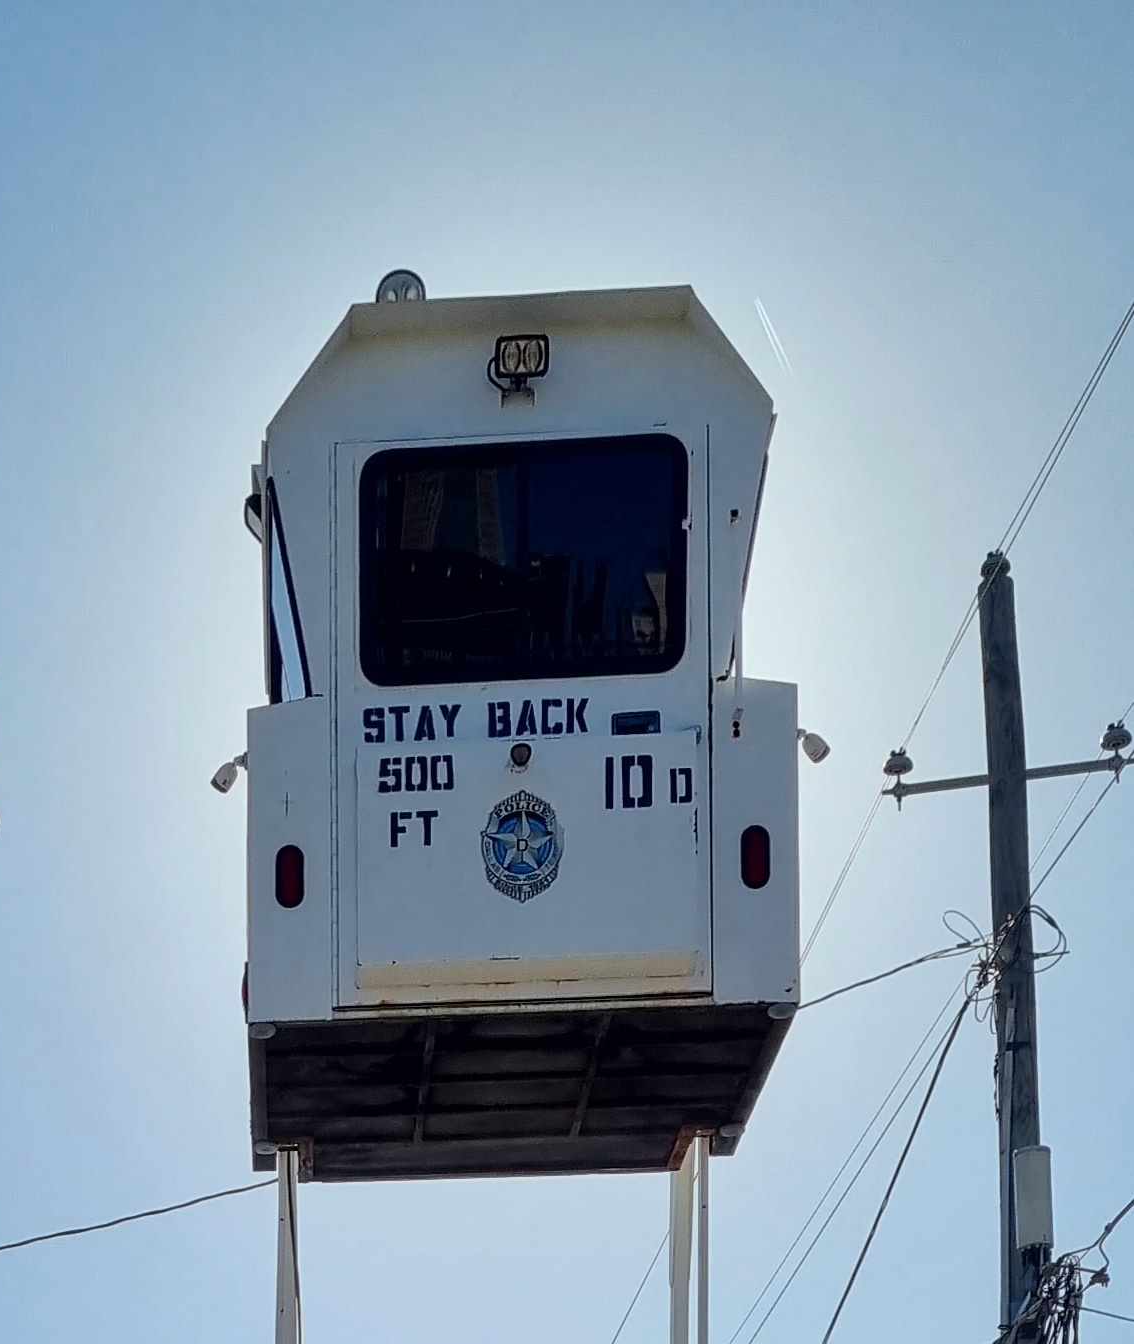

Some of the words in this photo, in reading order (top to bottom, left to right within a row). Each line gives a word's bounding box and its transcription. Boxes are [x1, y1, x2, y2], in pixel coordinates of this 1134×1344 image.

[362, 704, 462, 743] STAY
[487, 698, 589, 738] BACK
[378, 755, 454, 793] 500
[390, 810, 439, 847] FT
[493, 801, 551, 819] POLICE
[516, 838, 528, 852] D
